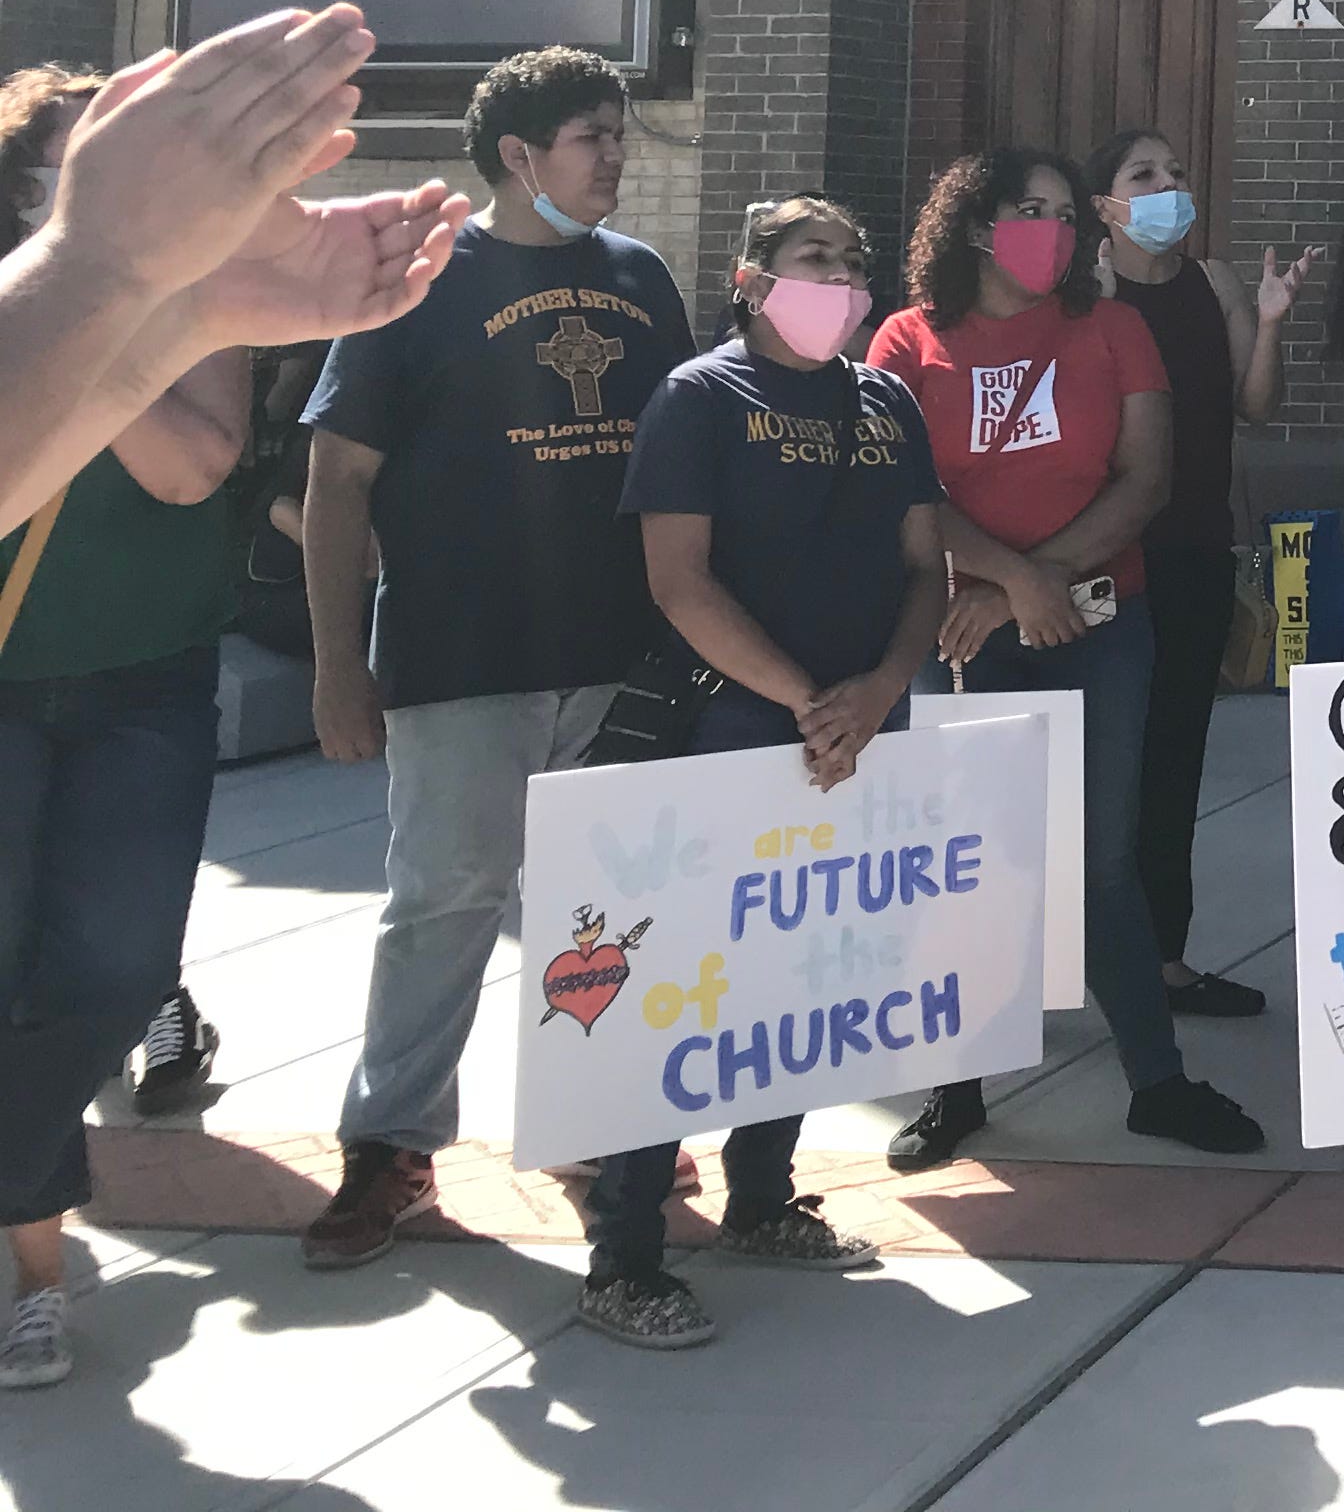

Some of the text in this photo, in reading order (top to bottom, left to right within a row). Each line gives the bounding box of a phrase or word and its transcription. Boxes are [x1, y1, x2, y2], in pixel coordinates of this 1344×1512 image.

[483, 288, 653, 339] MOTHER SETON
[746, 411, 907, 445] MOTHER ETON
[982, 390, 1006, 417] IS
[506, 427, 546, 444] The
[548, 422, 594, 439] Love
[597, 419, 614, 433] of
[533, 443, 592, 463] Urges
[588, 776, 946, 899] We are the
[731, 834, 982, 942] FUTURE
[642, 925, 903, 1030] of the
[662, 972, 961, 1112] CHURCH
